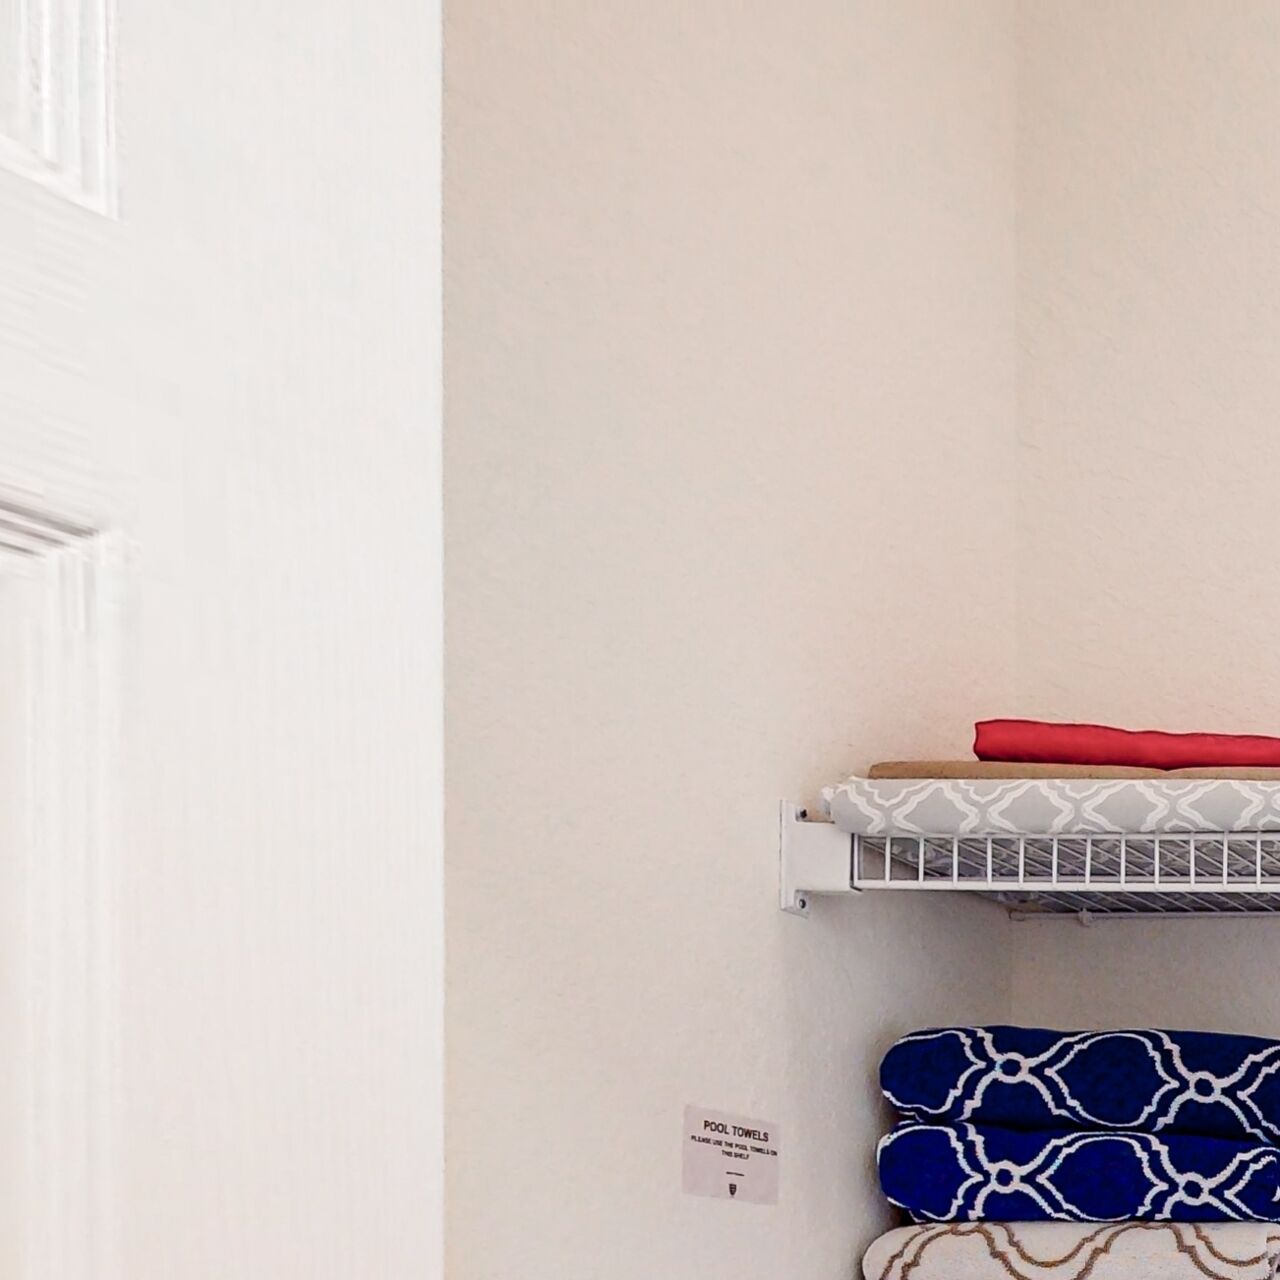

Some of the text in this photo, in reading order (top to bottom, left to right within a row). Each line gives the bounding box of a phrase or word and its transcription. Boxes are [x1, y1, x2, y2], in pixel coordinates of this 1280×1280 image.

[703, 1120, 769, 1142] POOL TOWELS
[691, 1135, 711, 1144] PLEASE
[735, 1143, 748, 1151] POOL
[749, 1146, 769, 1155] TOWELS
